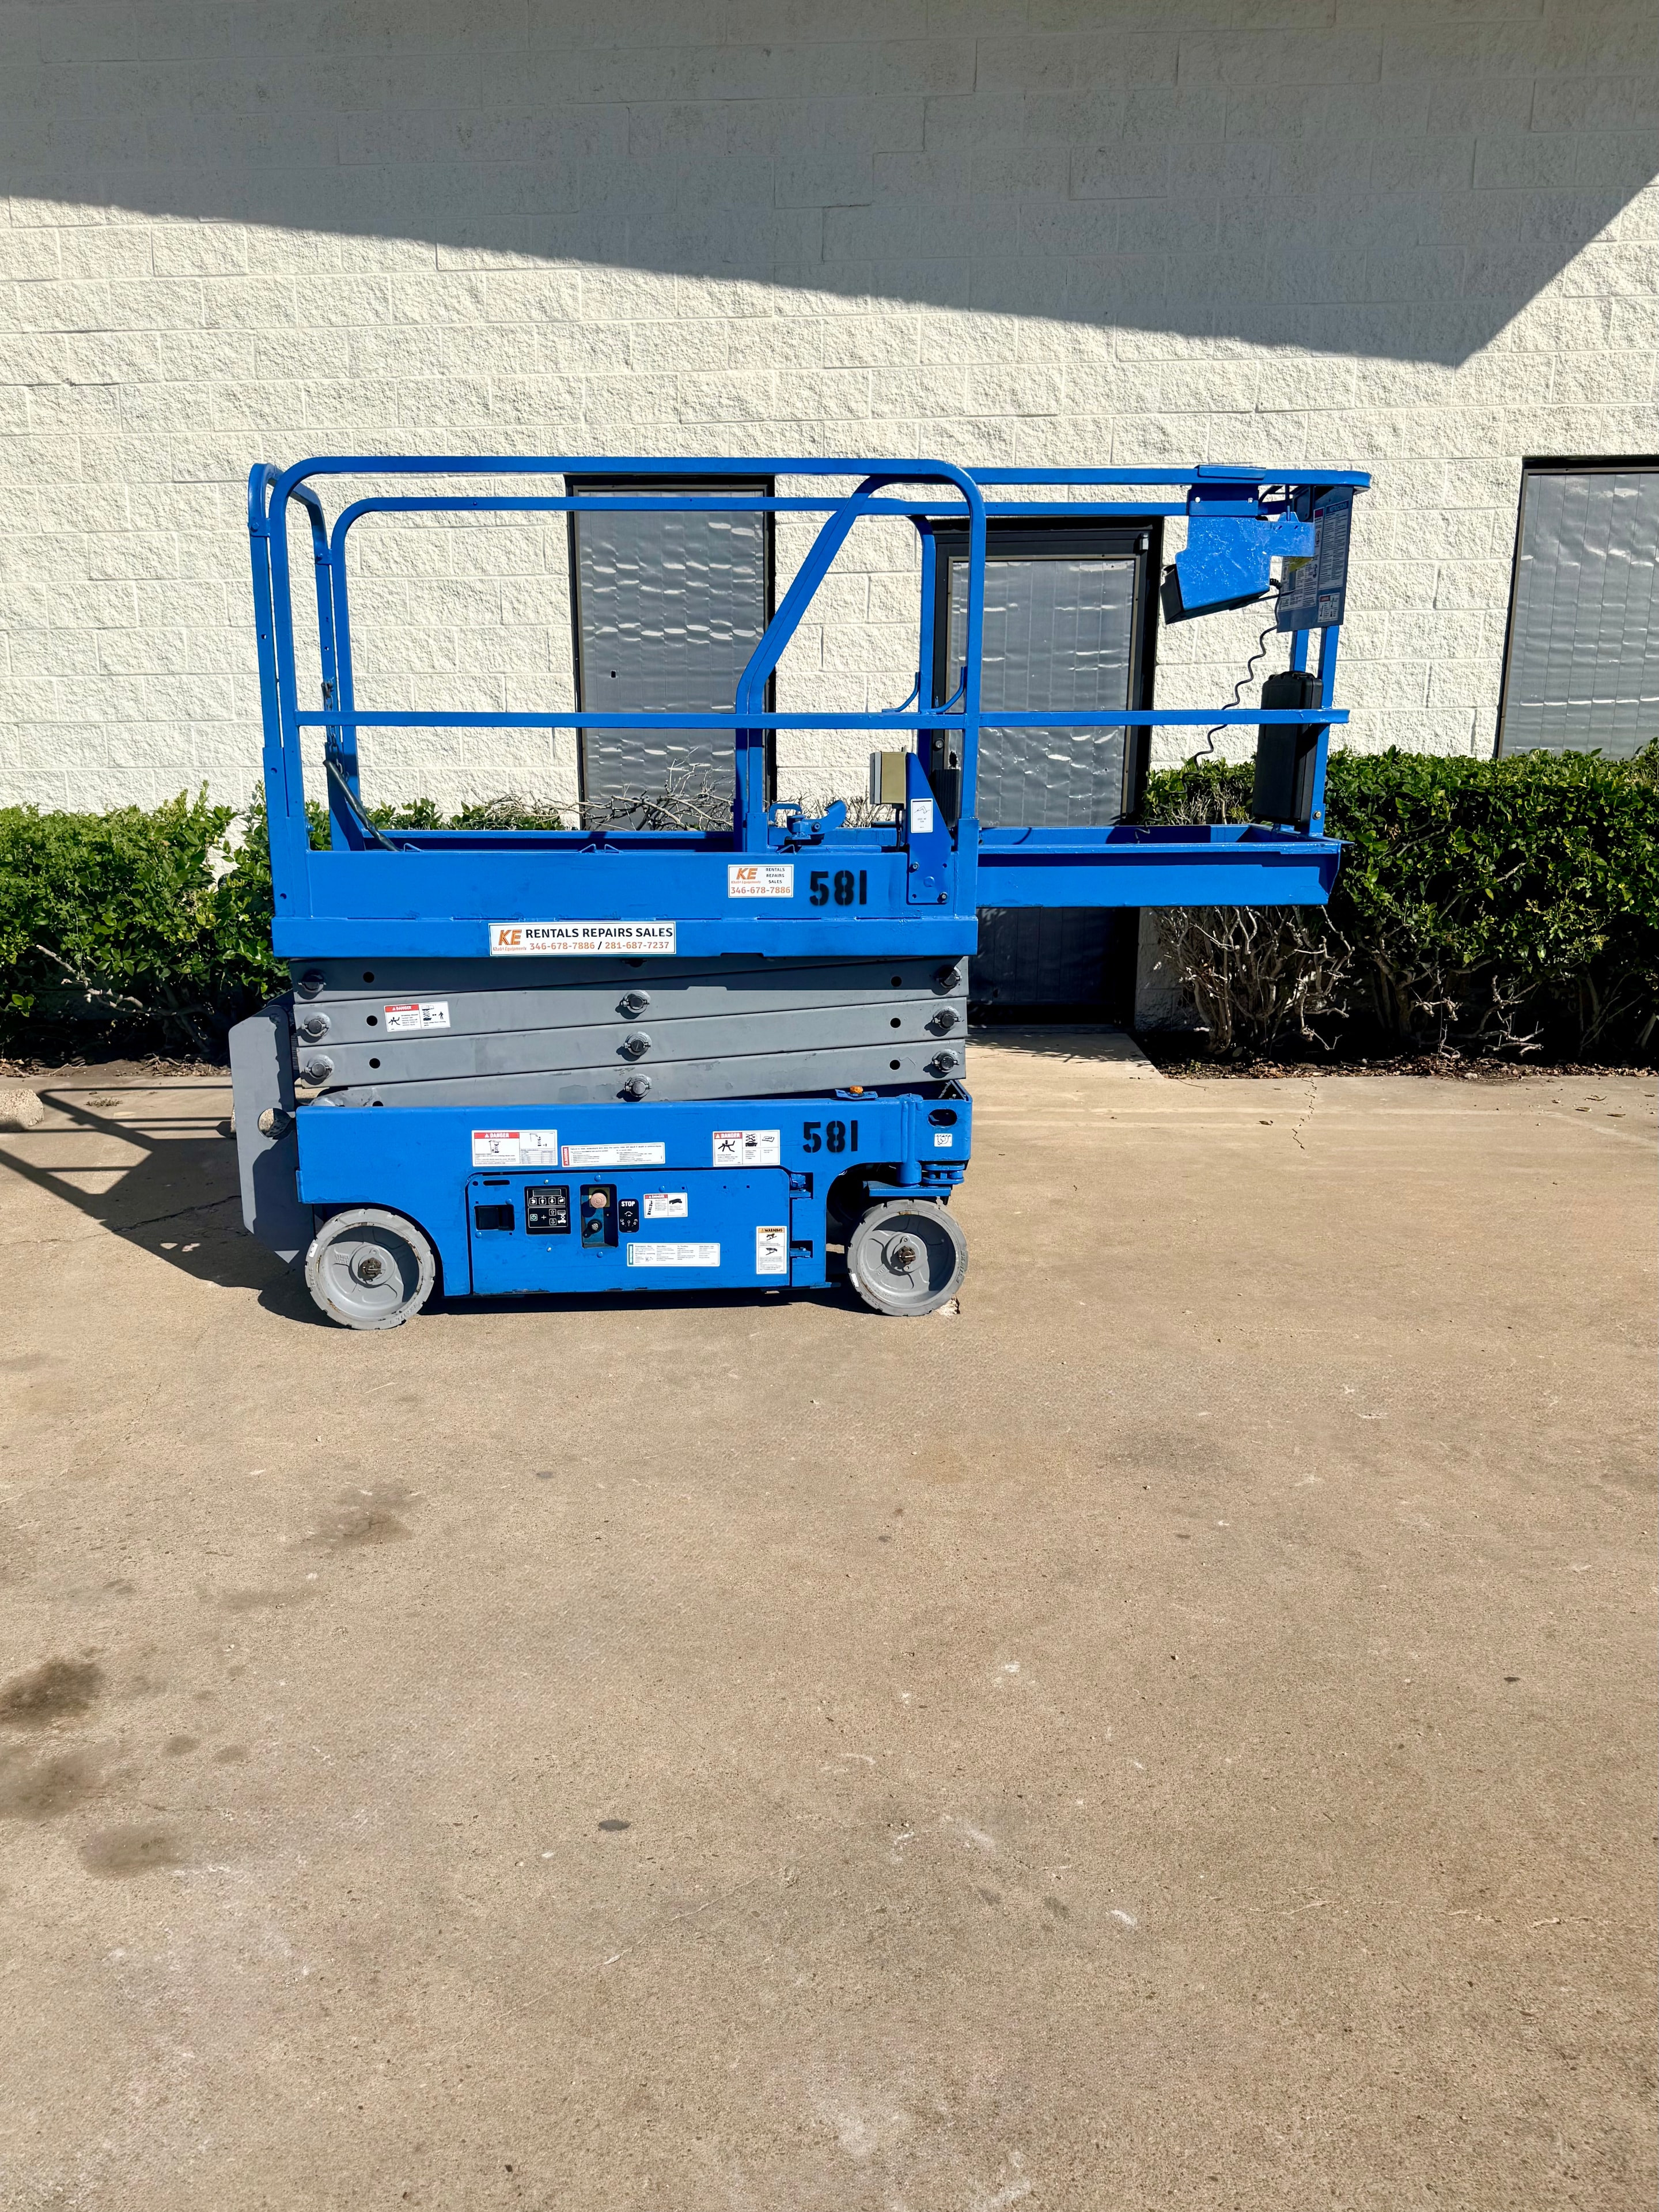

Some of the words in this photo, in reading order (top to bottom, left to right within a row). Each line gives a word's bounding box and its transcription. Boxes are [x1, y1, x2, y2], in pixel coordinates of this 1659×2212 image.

[736, 868, 757, 880] KE
[809, 870, 867, 906] 581
[498, 929, 522, 945] KE
[526, 929, 579, 938] RENTALS
[582, 928, 632, 937] REPAIRS
[635, 927, 673, 937] SALES
[530, 942, 595, 950] 346-678-7886
[597, 941, 603, 950] /
[605, 941, 669, 949] 281-687-7237
[802, 1120, 858, 1153] 581
